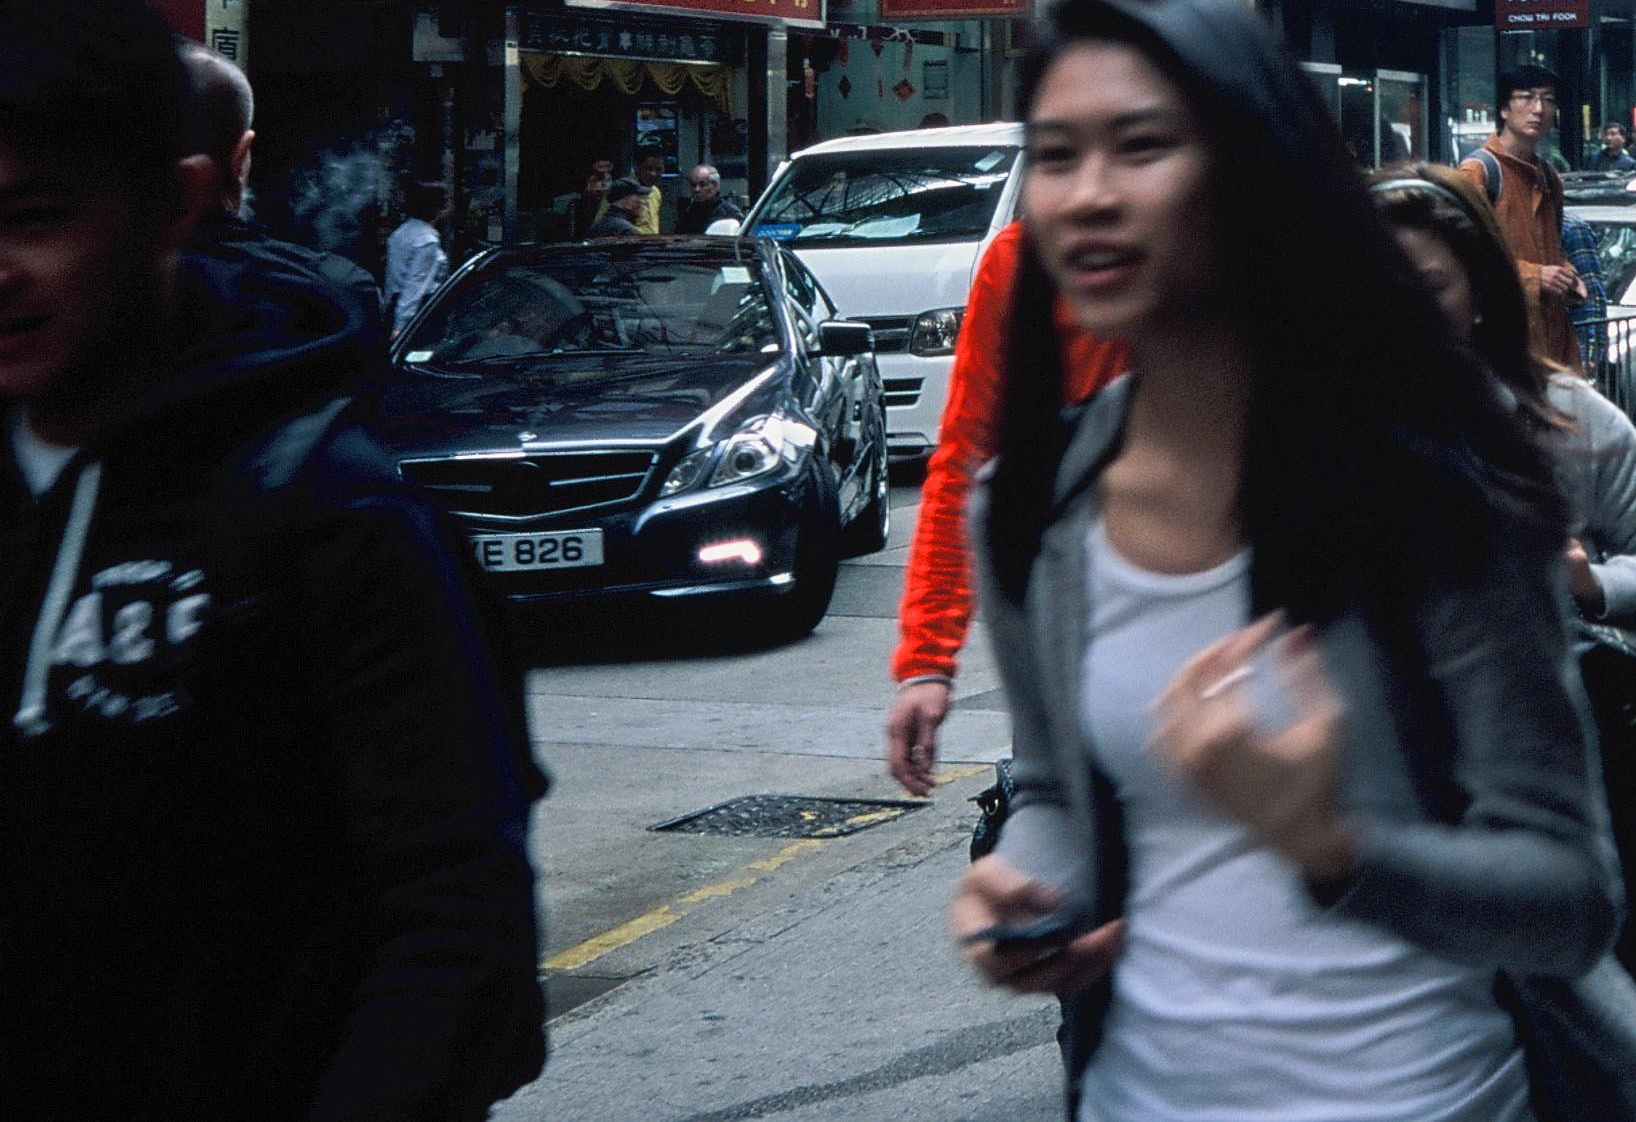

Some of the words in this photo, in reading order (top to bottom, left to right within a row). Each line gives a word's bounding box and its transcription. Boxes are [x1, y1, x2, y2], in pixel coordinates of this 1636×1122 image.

[1507, 13, 1534, 23] CHOW
[1535, 13, 1550, 22] TAI
[1552, 11, 1578, 22] FOOK
[514, 536, 584, 566] 826
